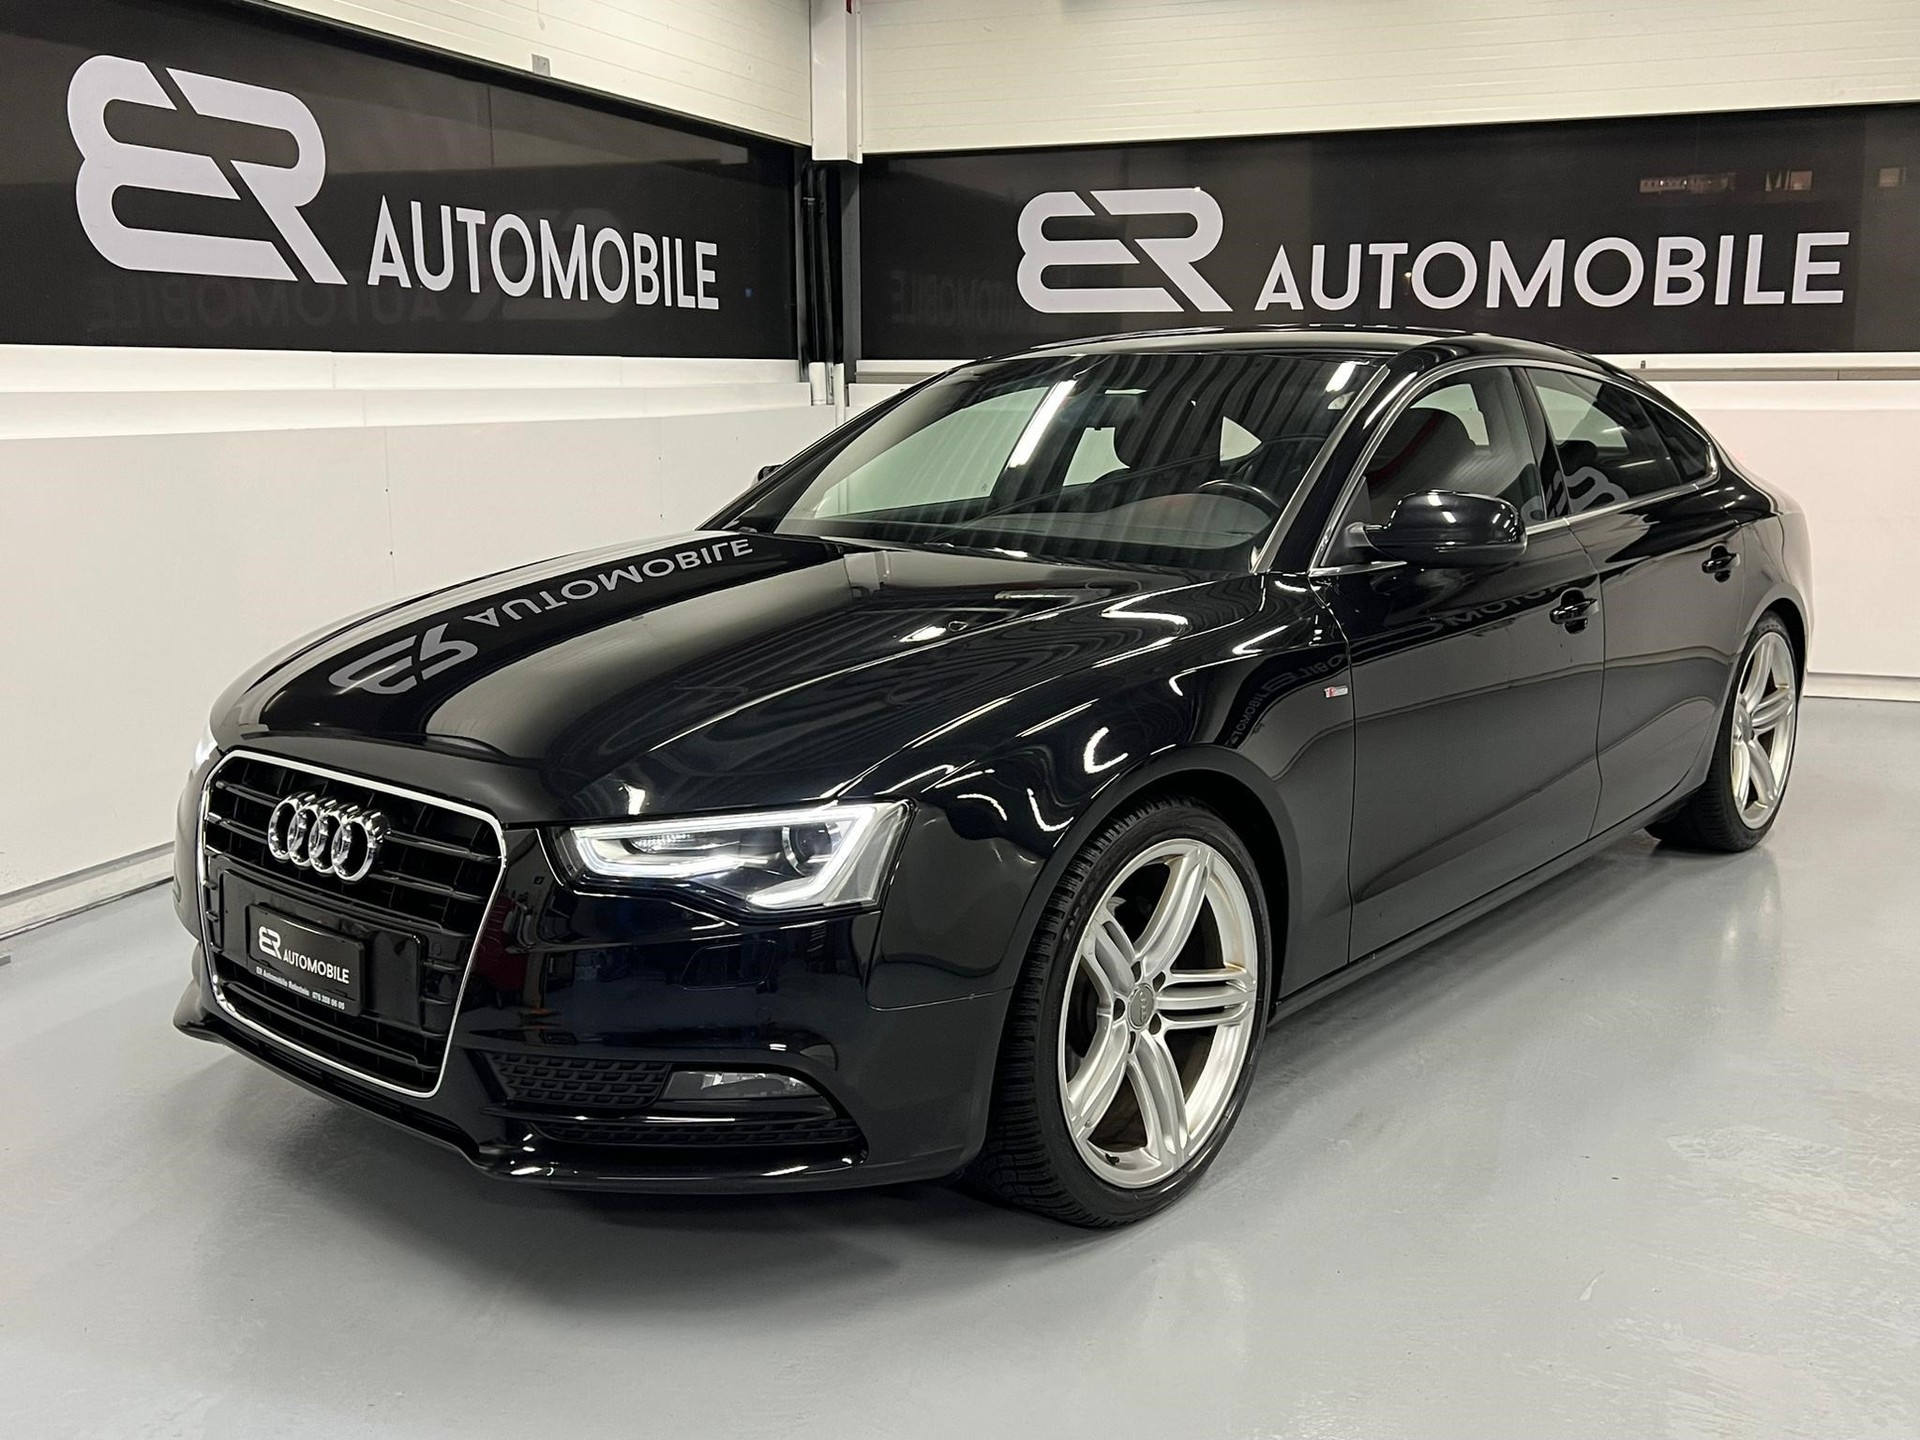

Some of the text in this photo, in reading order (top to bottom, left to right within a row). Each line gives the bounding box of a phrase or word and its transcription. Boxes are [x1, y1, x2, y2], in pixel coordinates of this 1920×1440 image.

[67, 55, 719, 310] ER AUTOMOBILE
[1017, 187, 1233, 313] ER
[1255, 232, 1849, 310] AUTOMOBILE
[283, 949, 350, 984] AUTOMOBILE
